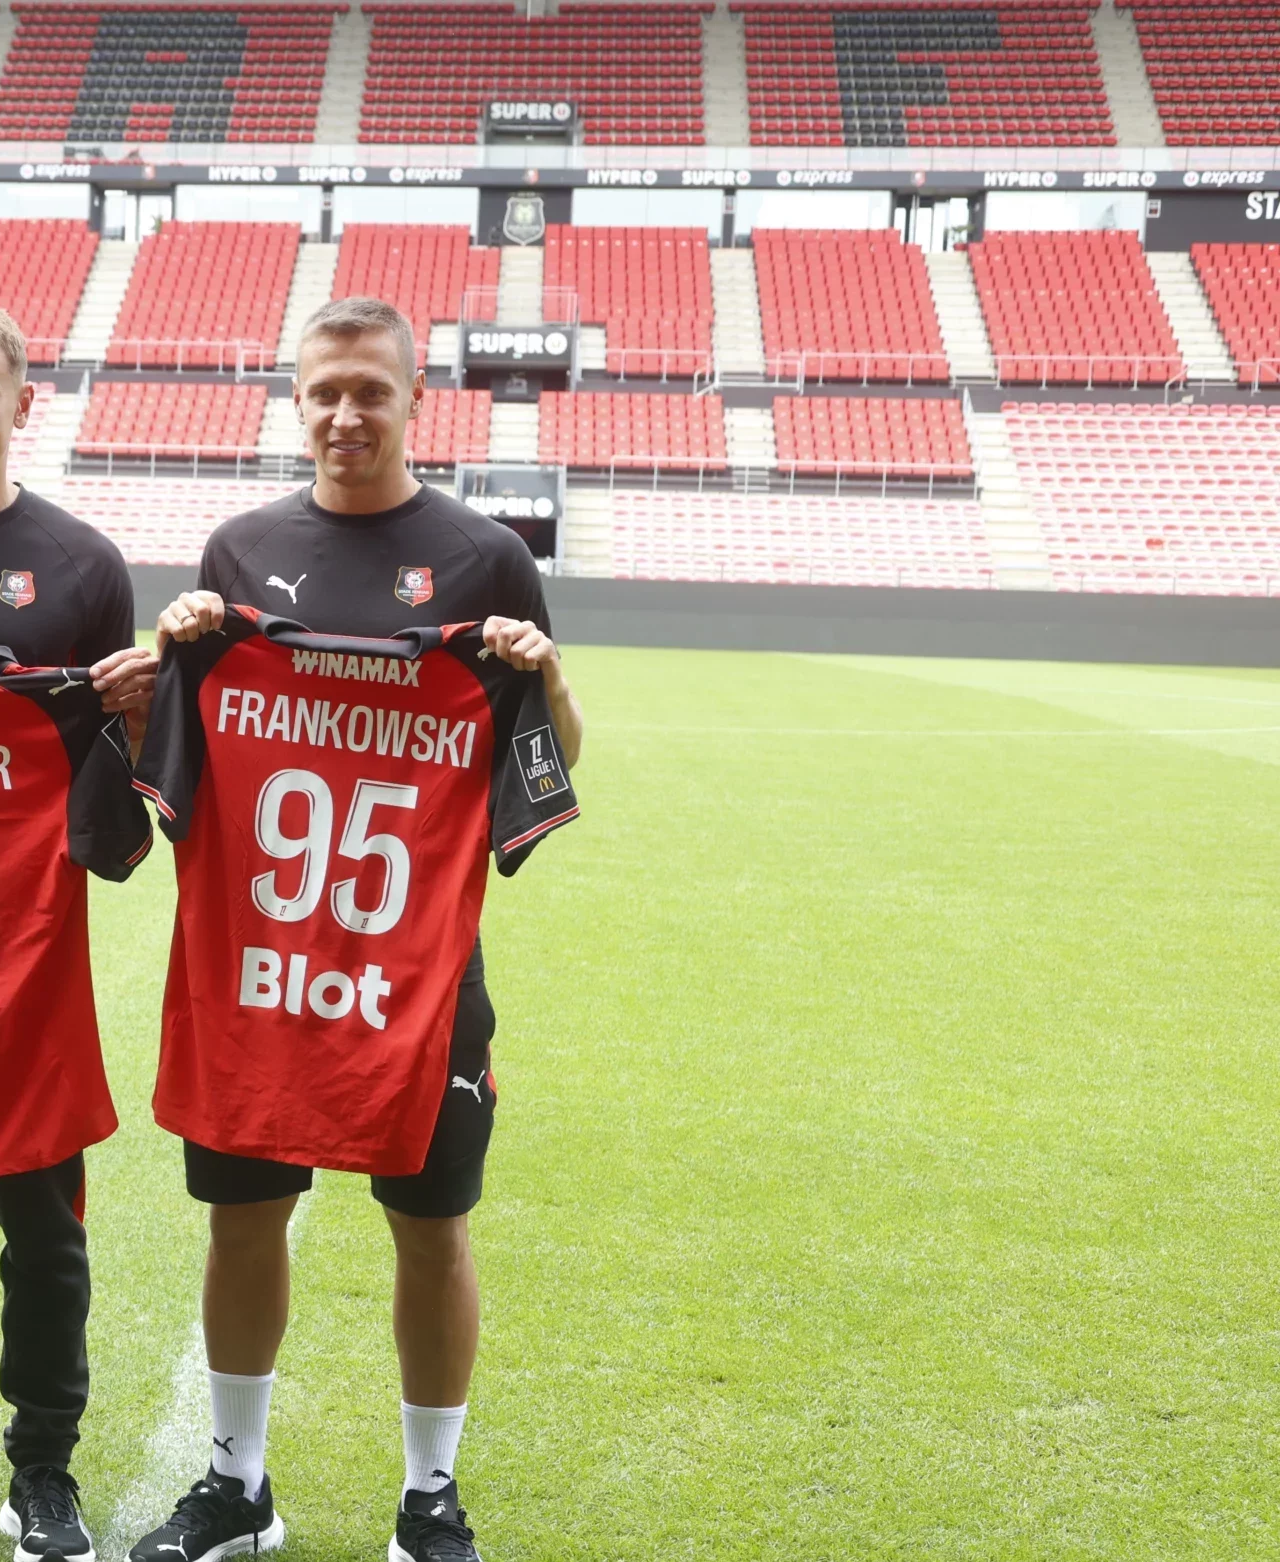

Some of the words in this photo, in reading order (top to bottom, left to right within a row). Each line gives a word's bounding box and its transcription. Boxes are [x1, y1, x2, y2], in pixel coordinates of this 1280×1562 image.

[490, 102, 551, 120] SUPER
[35, 164, 91, 179] express
[208, 165, 261, 181] HYPER
[298, 166, 350, 181] SUPER
[405, 167, 463, 183] express
[586, 169, 642, 184] HYPER
[682, 170, 735, 185] SUPER
[793, 170, 854, 187] express
[983, 171, 1040, 187] HYPER
[1082, 172, 1139, 187] SUPER
[1201, 171, 1265, 187] express
[468, 332, 544, 354] SUPER
[291, 649, 423, 688] WINAMAX
[217, 687, 477, 769] FRANKOWSKI
[526, 761, 551, 780] LIGUE
[251, 768, 419, 935] 95
[239, 946, 392, 1031] Blot
